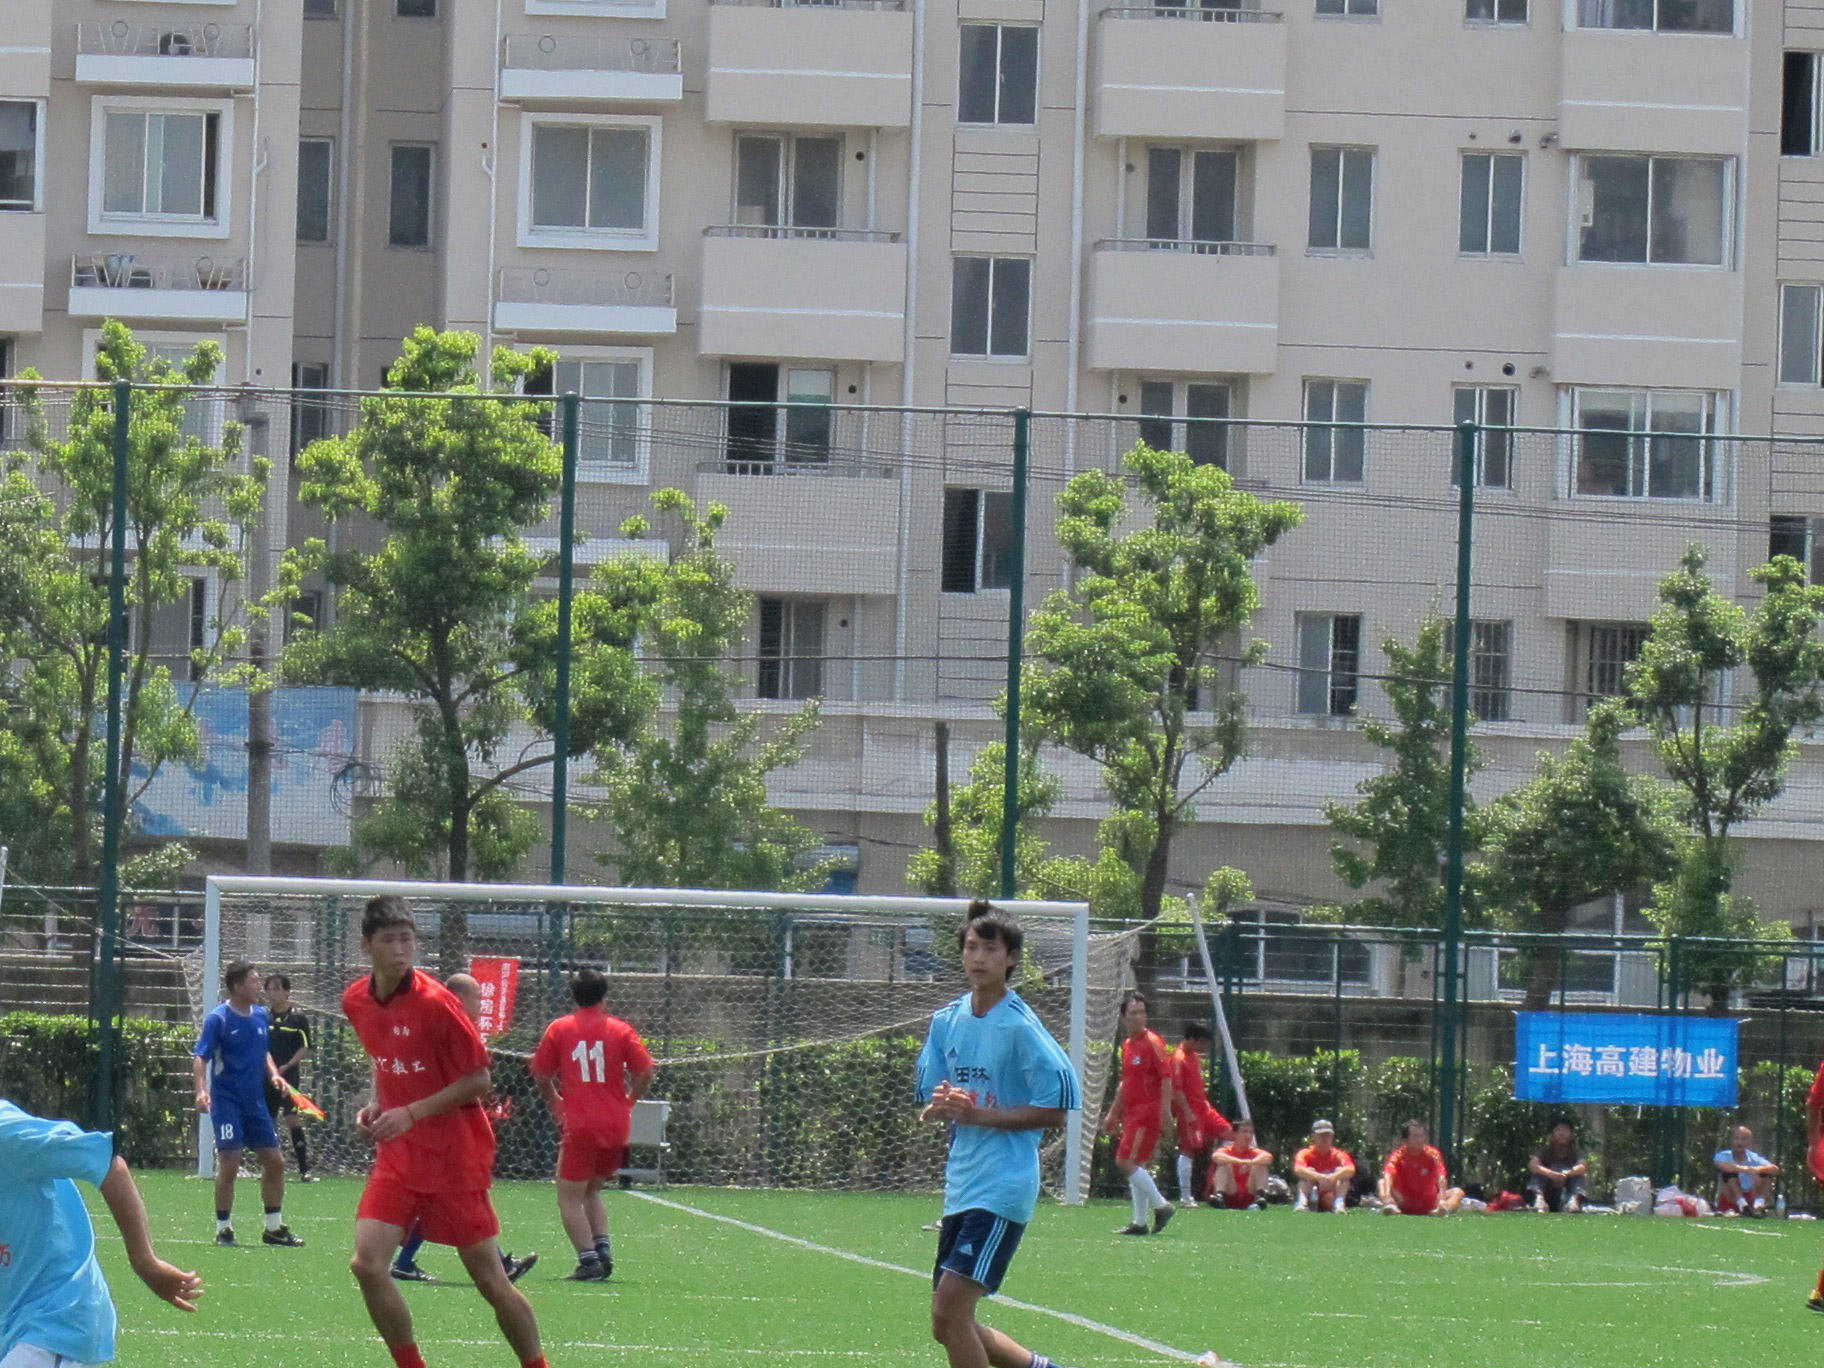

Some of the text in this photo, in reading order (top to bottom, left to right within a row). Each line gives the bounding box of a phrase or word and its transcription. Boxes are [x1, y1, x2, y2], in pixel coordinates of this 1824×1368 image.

[571, 1040, 606, 1083] 11
[1528, 1042, 1726, 1078] 上海高建物业
[220, 1123, 235, 1140] 18
